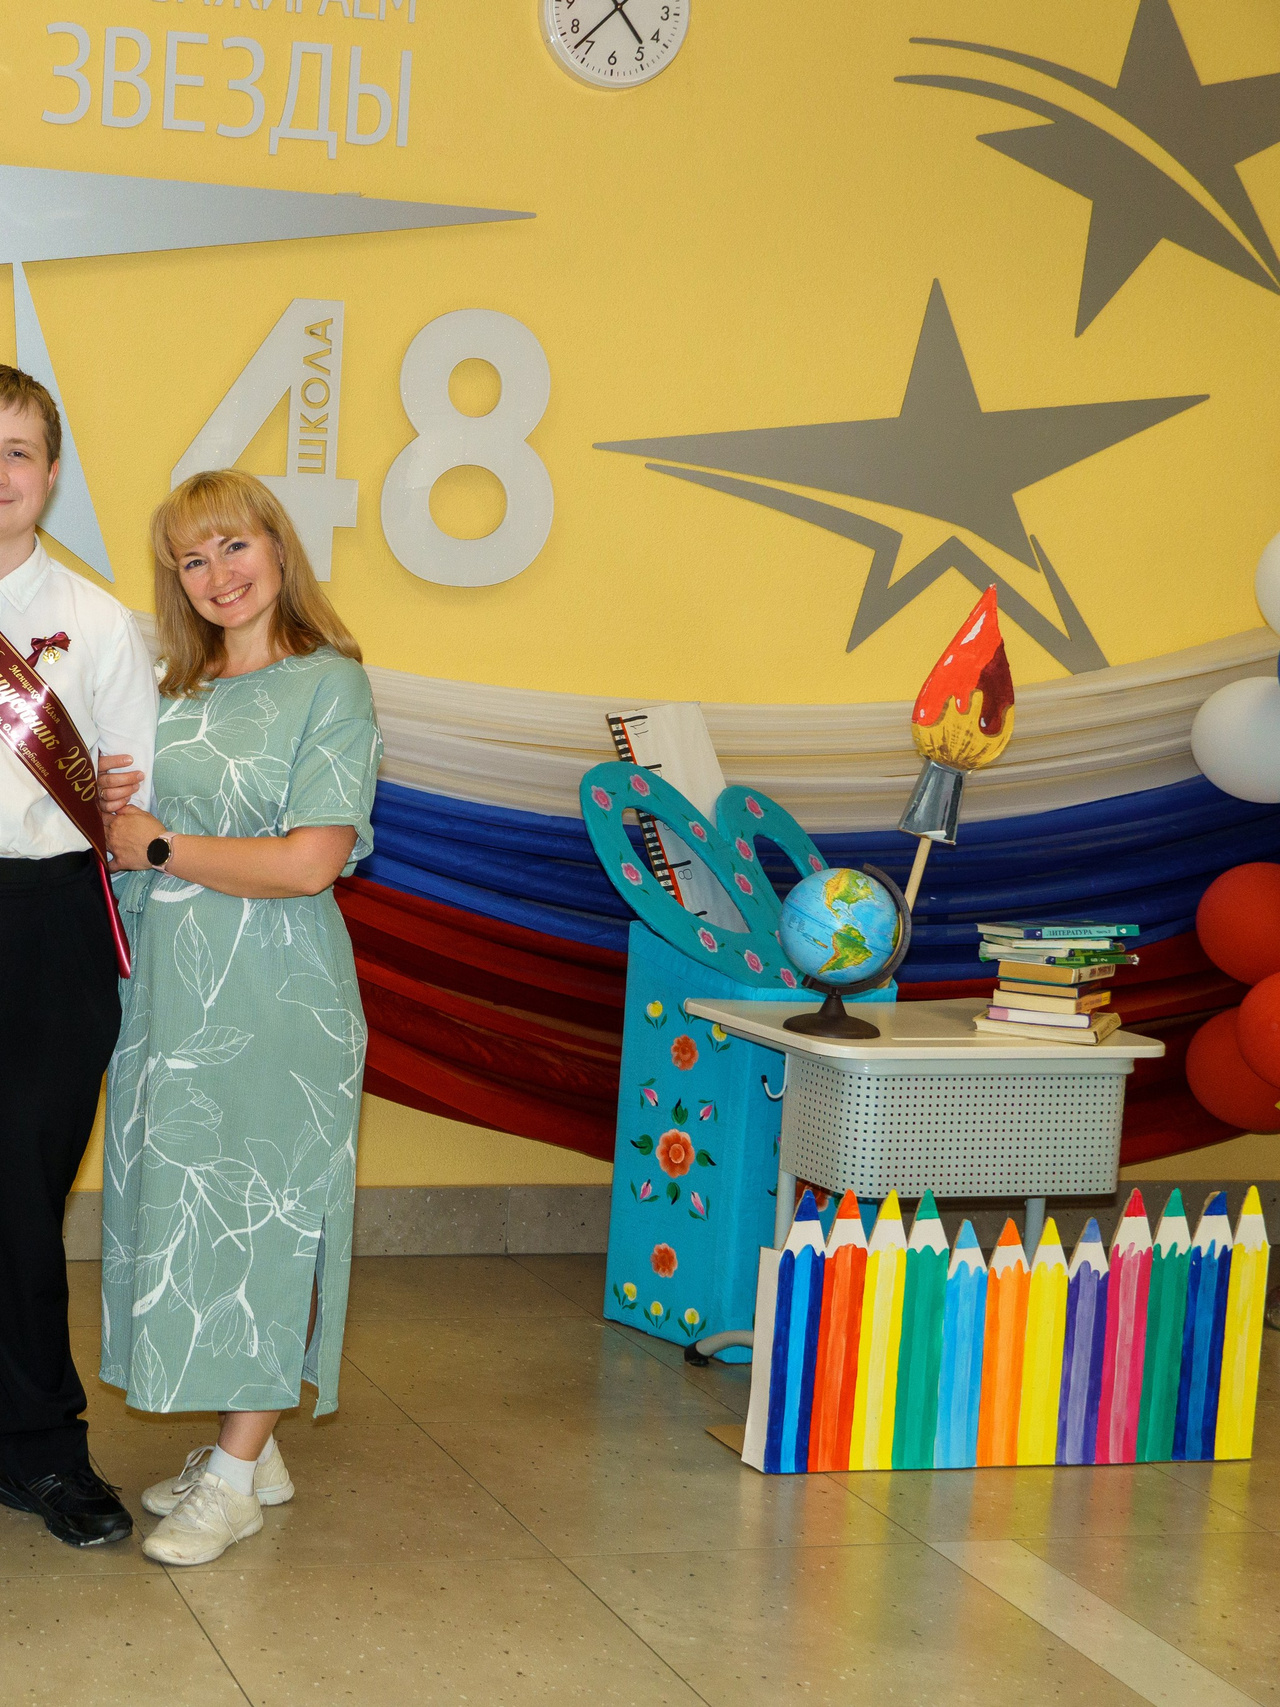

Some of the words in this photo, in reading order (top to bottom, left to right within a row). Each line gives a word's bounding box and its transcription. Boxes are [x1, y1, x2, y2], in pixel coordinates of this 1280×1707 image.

[660, 5, 670, 21] 3
[570, 18, 580, 34] 8
[650, 28, 660, 43] 4
[585, 40, 596, 55] 7
[634, 46, 645, 62] 5
[607, 50, 617, 65] 6
[41, 22, 412, 160] ЗВЕЗДЫ
[298, 317, 334, 474] ШКОЛА
[171, 298, 554, 588] 48
[42, 702, 61, 724] Илья
[18, 739, 50, 777] Карбышева
[678, 868, 693, 880] 8
